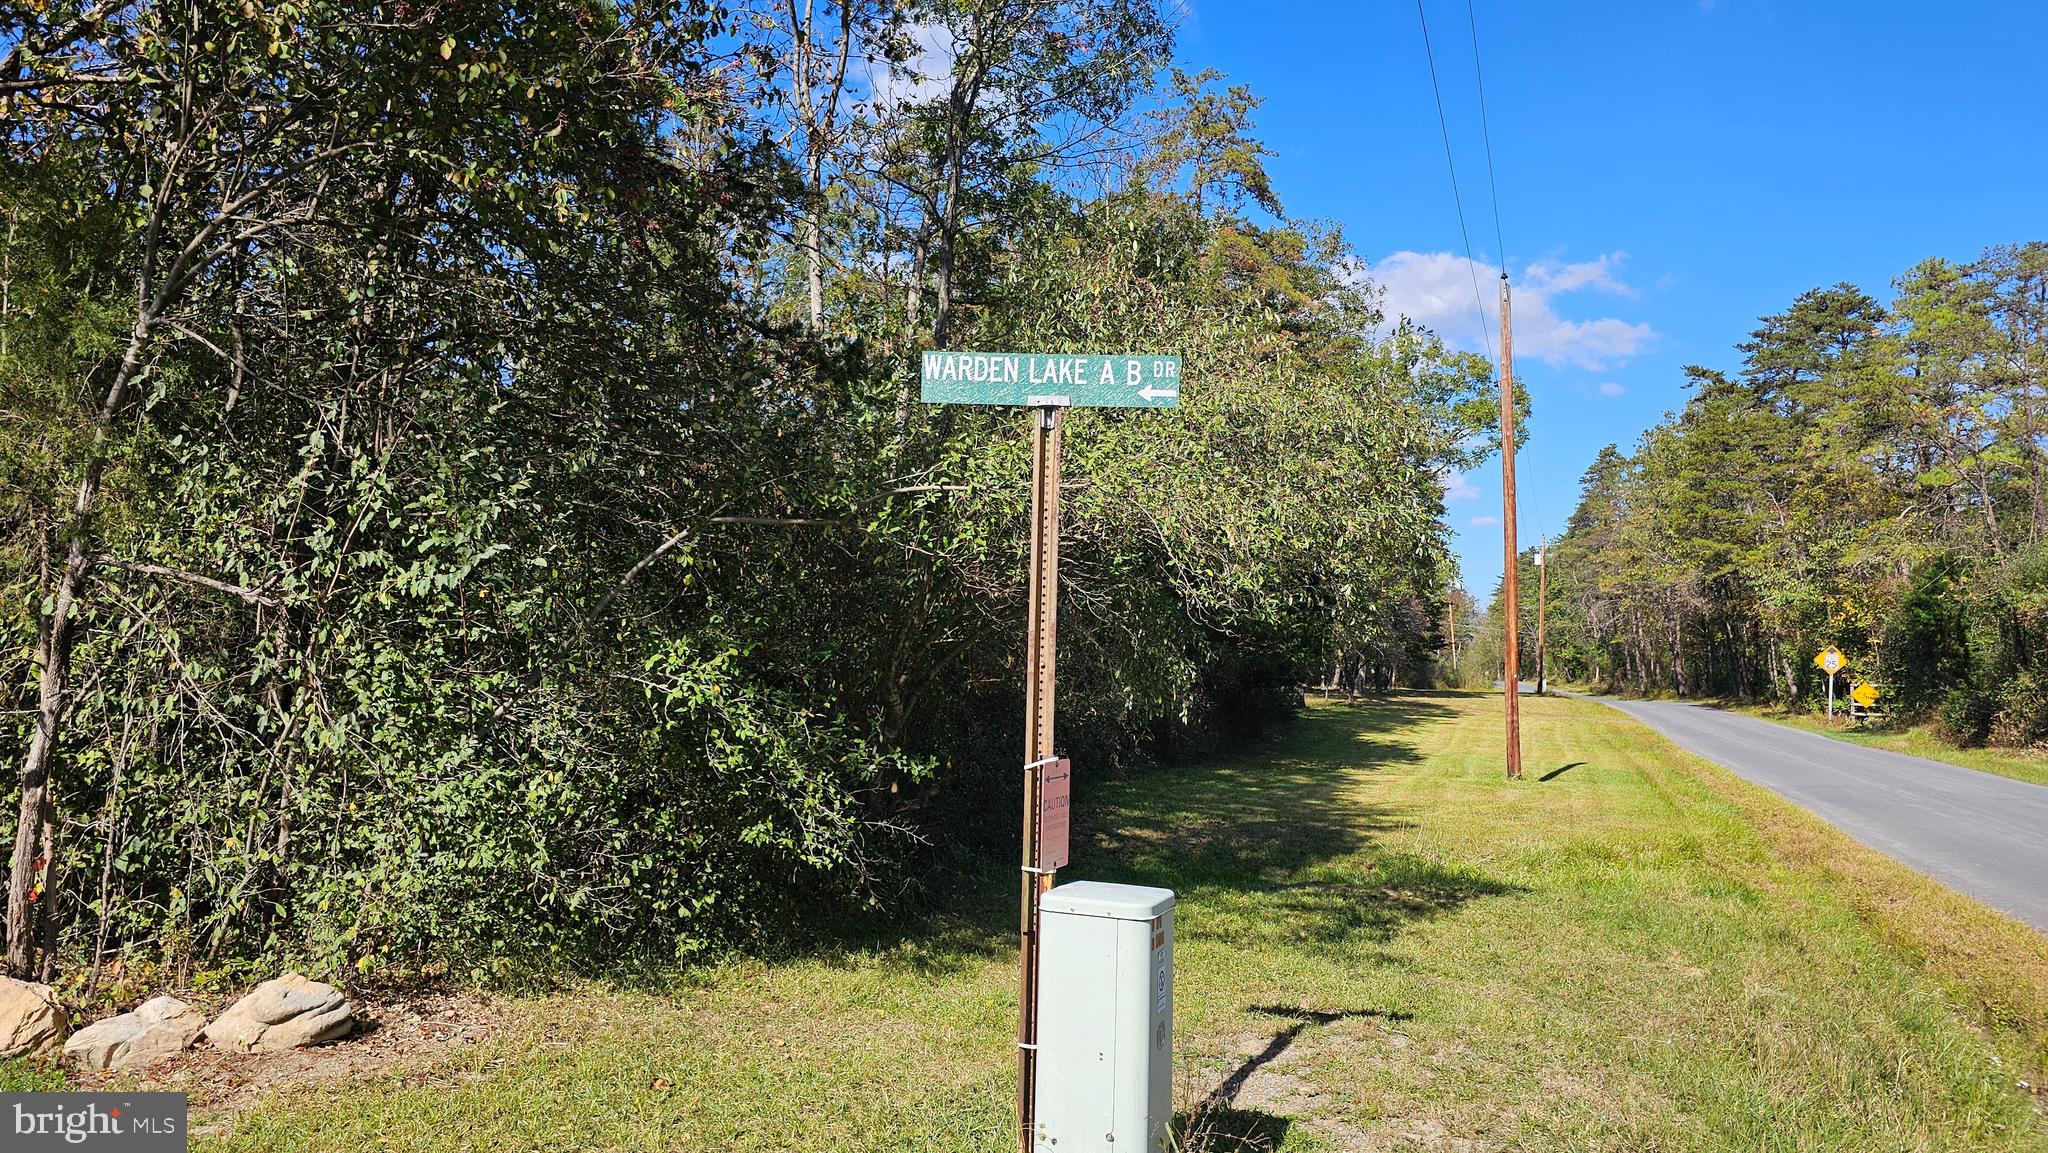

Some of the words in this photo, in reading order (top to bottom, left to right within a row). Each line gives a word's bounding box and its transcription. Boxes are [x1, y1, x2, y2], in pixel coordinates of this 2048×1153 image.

[924, 354, 1018, 383] WARDEN
[1029, 355, 1088, 385] LAKE
[1100, 361, 1115, 385] A
[1127, 361, 1142, 386] B
[1154, 362, 1176, 378] DR
[1826, 660, 1837, 669] 25
[1043, 795, 1070, 812] CAUTION
